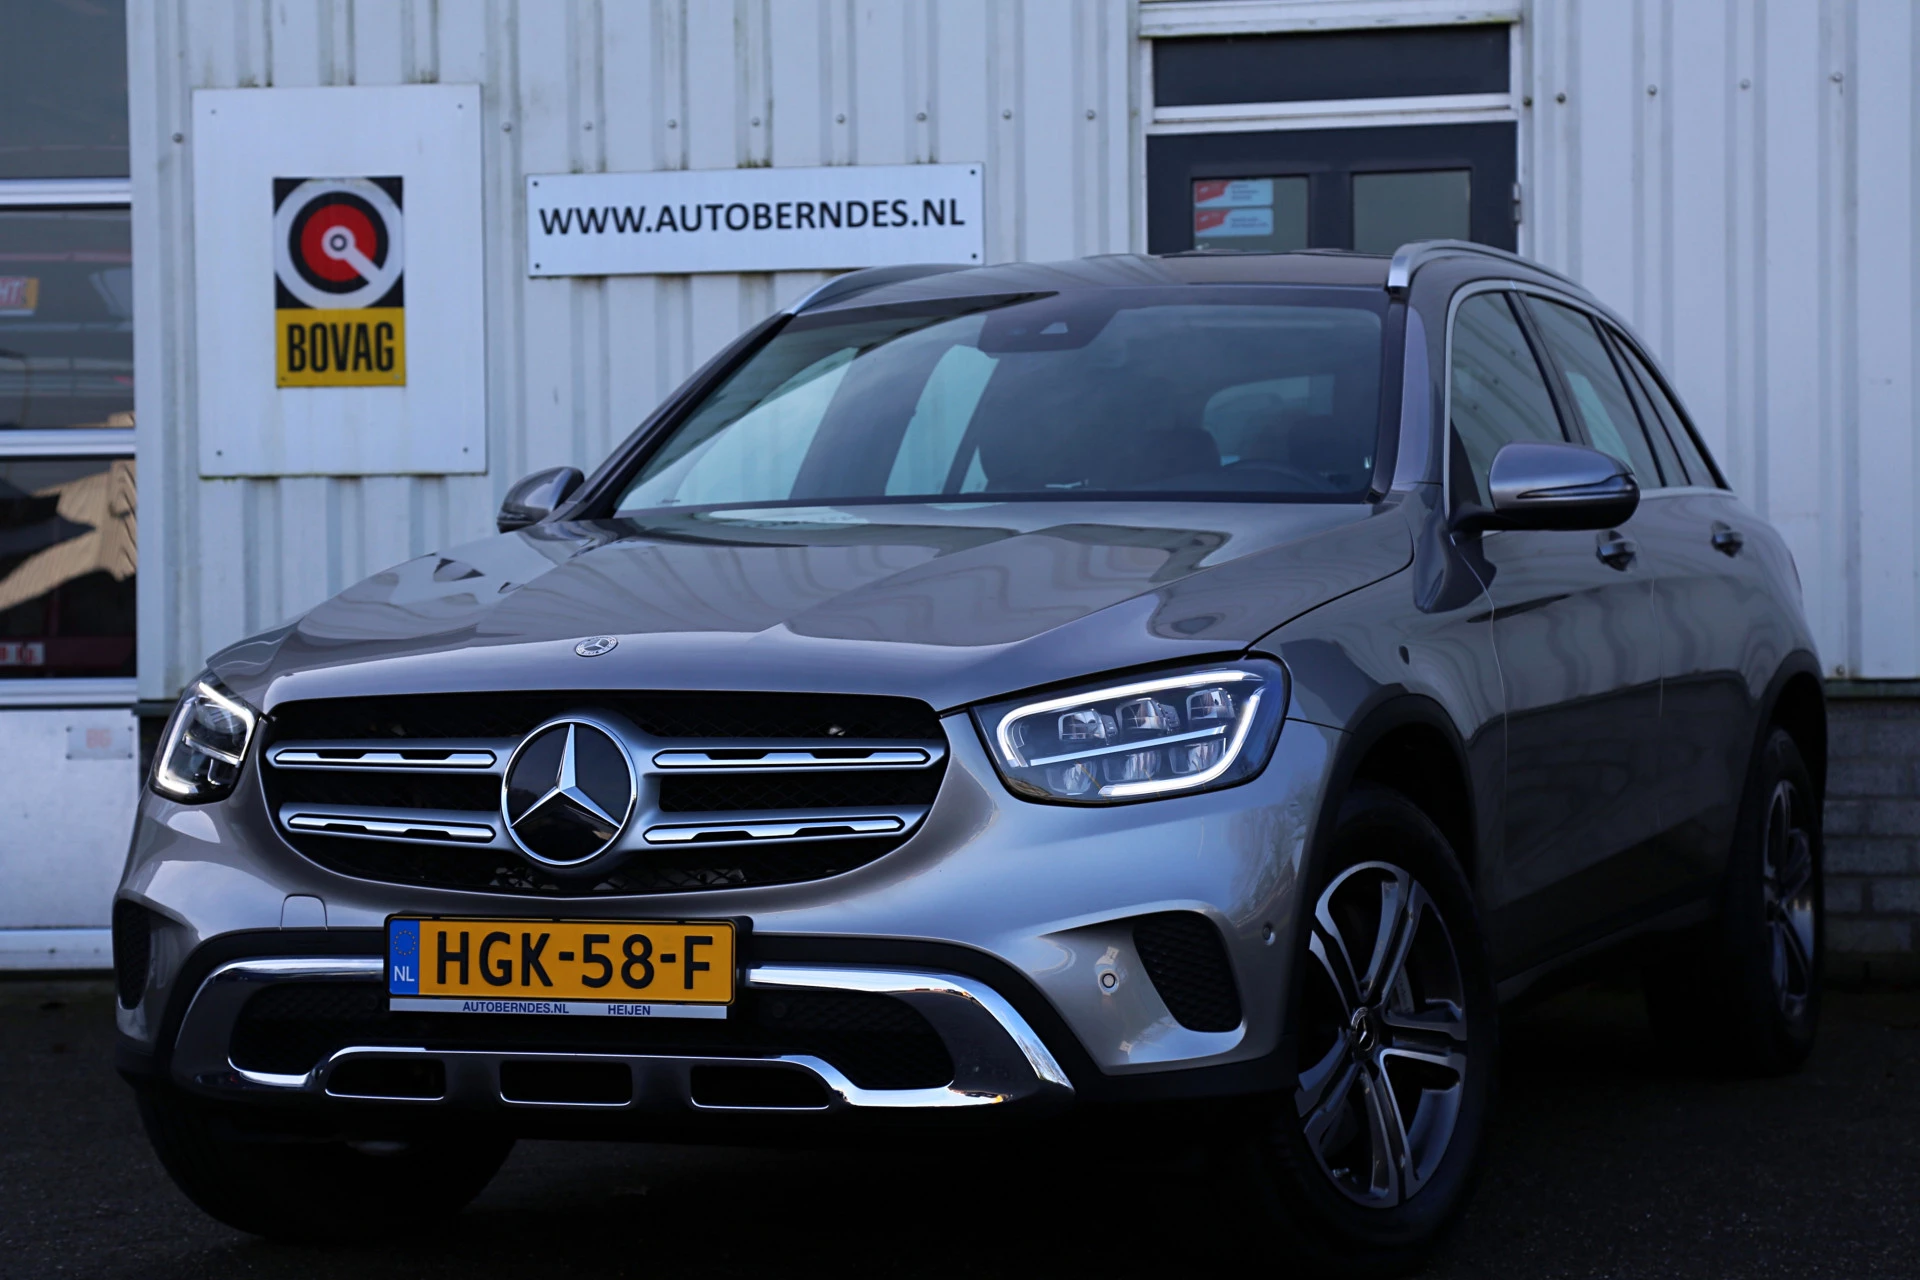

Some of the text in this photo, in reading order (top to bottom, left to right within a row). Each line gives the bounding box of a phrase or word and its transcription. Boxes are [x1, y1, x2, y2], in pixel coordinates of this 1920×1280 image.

[540, 198, 965, 235] WWW.AUTOBERNDES.NL
[287, 322, 394, 373] BOVAG
[394, 965, 415, 982] NL
[436, 931, 713, 990] HGK-58-F
[462, 1002, 651, 1016] AUTOBERNDES.NL HEIJEN
